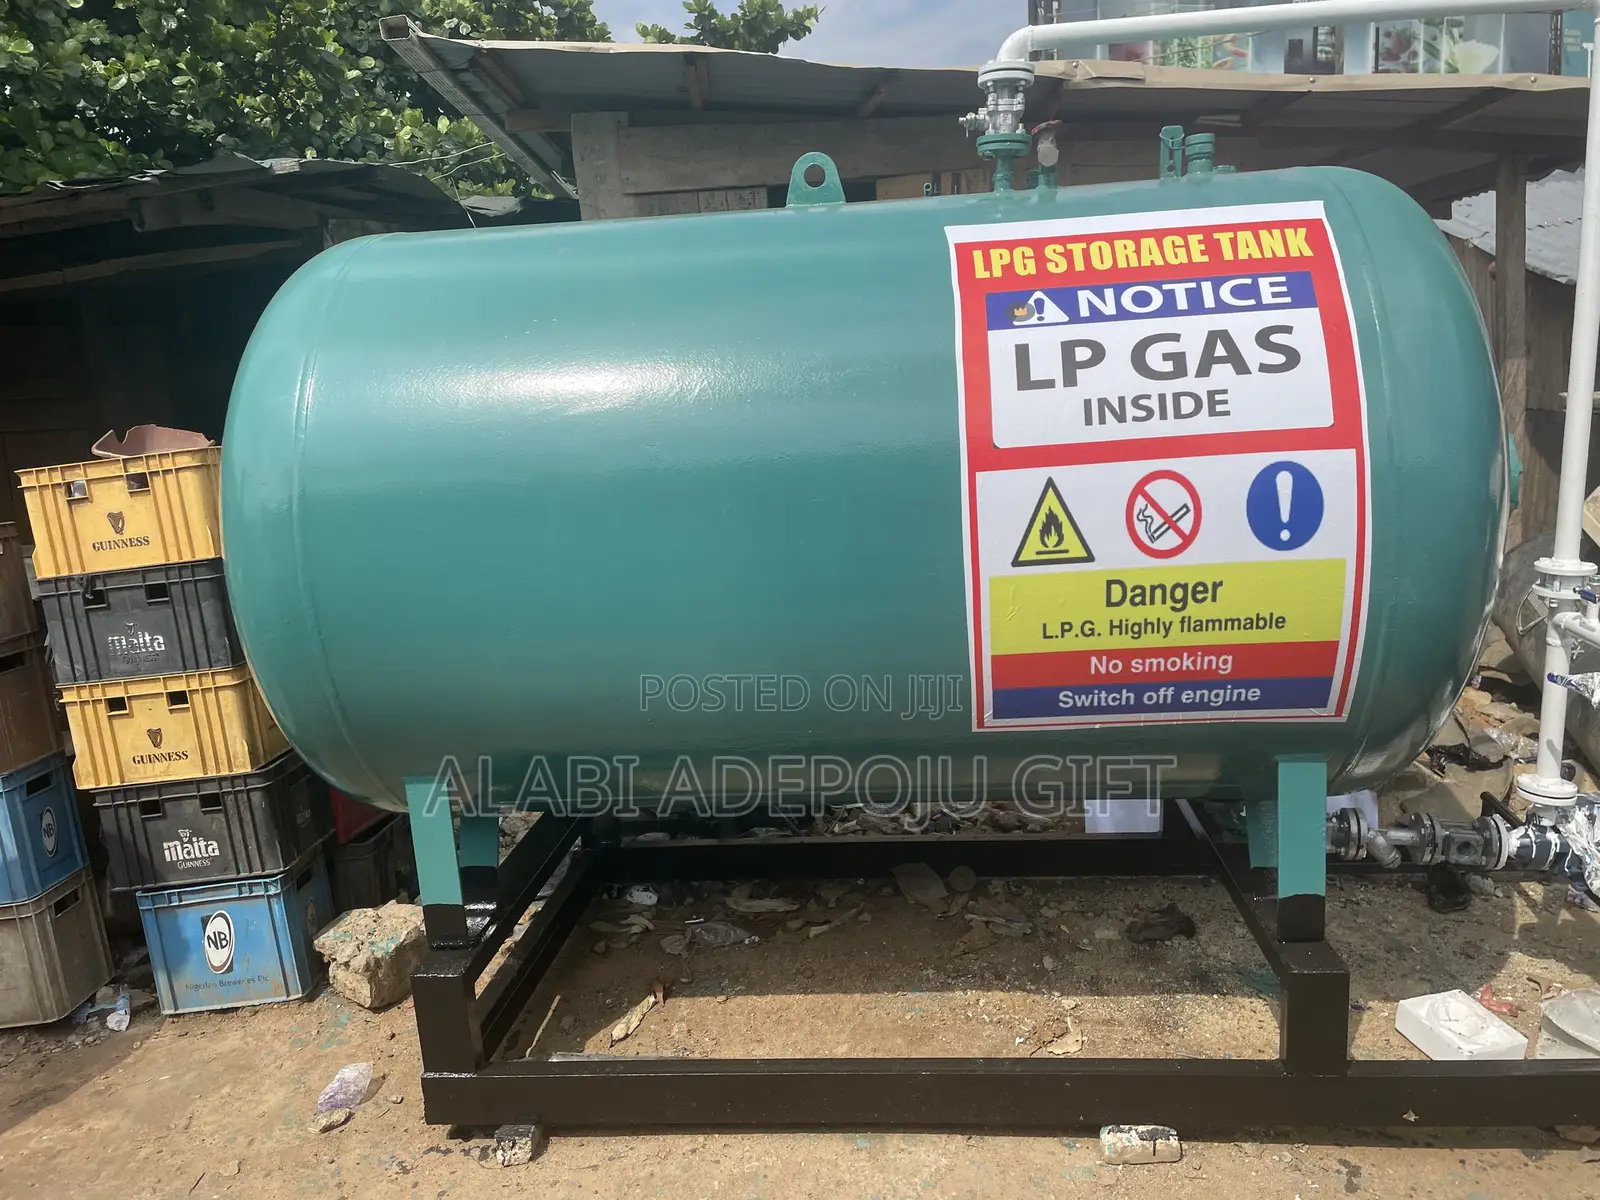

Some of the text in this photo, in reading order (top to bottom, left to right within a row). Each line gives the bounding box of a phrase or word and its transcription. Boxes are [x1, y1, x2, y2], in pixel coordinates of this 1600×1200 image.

[973, 227, 1315, 279] LPG STORAGE TANK
[1077, 275, 1292, 318] NOTICE
[1014, 324, 1302, 391] LP GAS
[1083, 388, 1232, 427] INSIDE
[91, 535, 151, 552] GUINNESS
[1105, 578, 1224, 612] Danger
[1042, 612, 1287, 640] L.P.G. Highly flammable
[108, 631, 166, 656] malta
[1090, 652, 1233, 675] No smoking
[1058, 685, 1261, 708] Switch off engine
[131, 750, 189, 766] GUINNESS
[163, 836, 220, 862] malta
[177, 859, 211, 869] GUINNESS
[206, 930, 229, 950] NB
